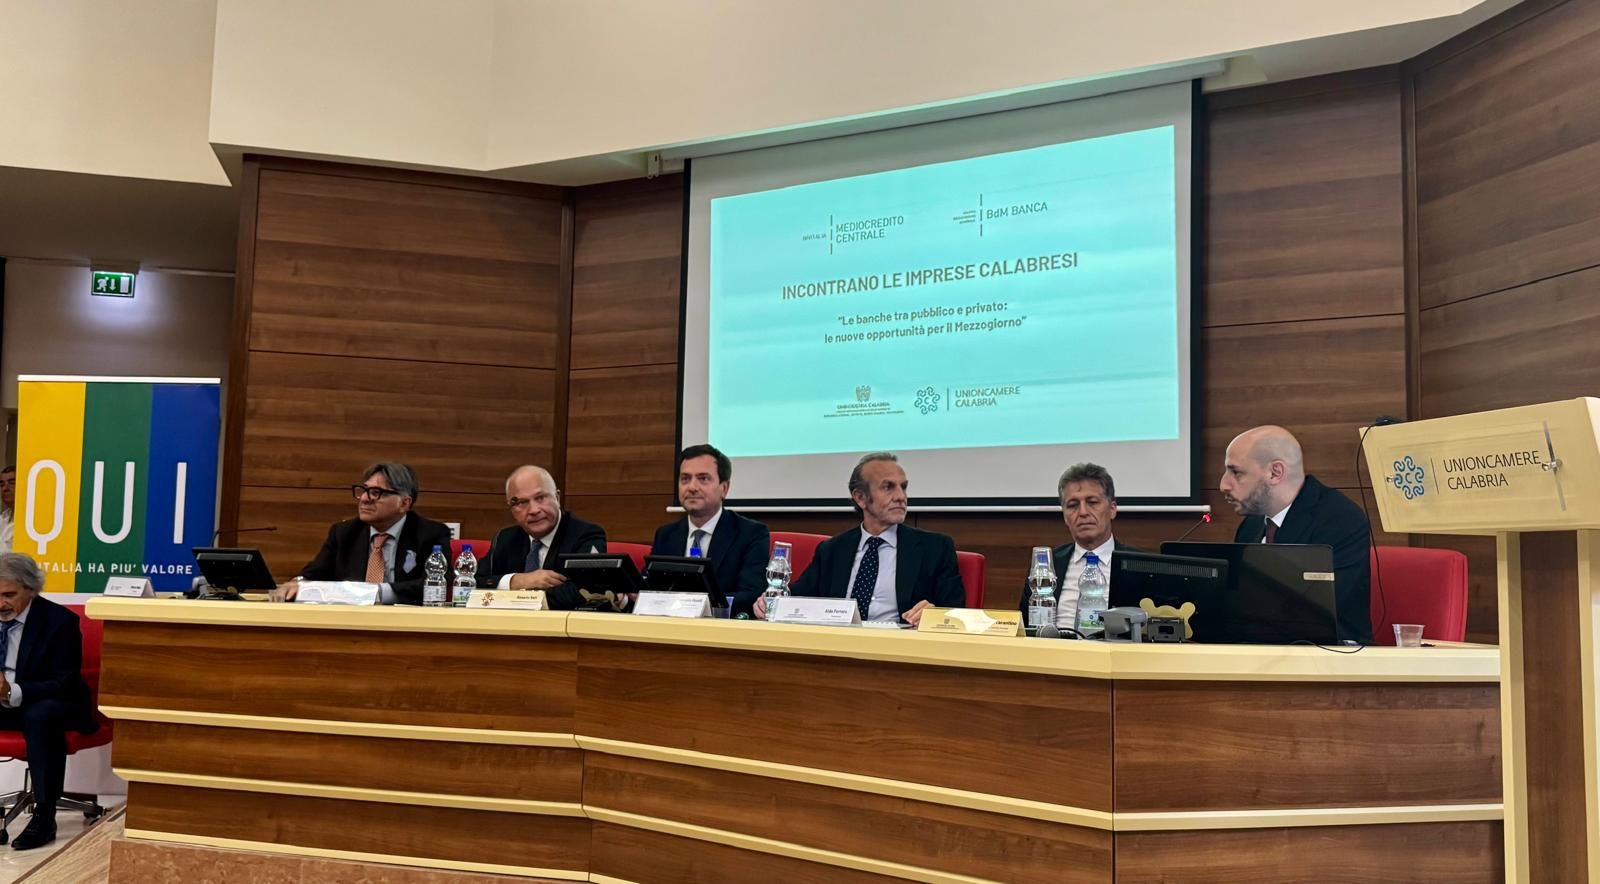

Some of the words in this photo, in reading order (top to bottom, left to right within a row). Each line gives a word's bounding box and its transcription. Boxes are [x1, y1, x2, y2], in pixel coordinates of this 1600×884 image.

[986, 207, 1009, 219] BdM
[1011, 202, 1048, 216] BANCA
[835, 215, 904, 233] MEDIOCREDITO
[836, 228, 885, 244] CENTRALE
[782, 275, 879, 300] INCONTRANO
[882, 272, 903, 289] LE
[905, 264, 976, 286] IMPRESE
[979, 252, 1078, 278] CALABRESI
[856, 312, 893, 325] banche
[894, 311, 909, 321] tra
[910, 306, 955, 321] pubblico
[956, 306, 964, 315] e
[965, 301, 1008, 317] privato:
[824, 333, 833, 343] le
[835, 332, 865, 343] nuove
[866, 325, 926, 341] opportunità
[927, 325, 945, 336] per
[955, 385, 1021, 399] UNIONCAMERE
[955, 397, 997, 408] CALABRIA
[1443, 450, 1542, 473] UNIONCAMERE
[1447, 472, 1509, 490] CALABRIA
[25, 459, 188, 555] QUI
[88, 562, 105, 573] HA
[142, 563, 193, 575] VALORE
